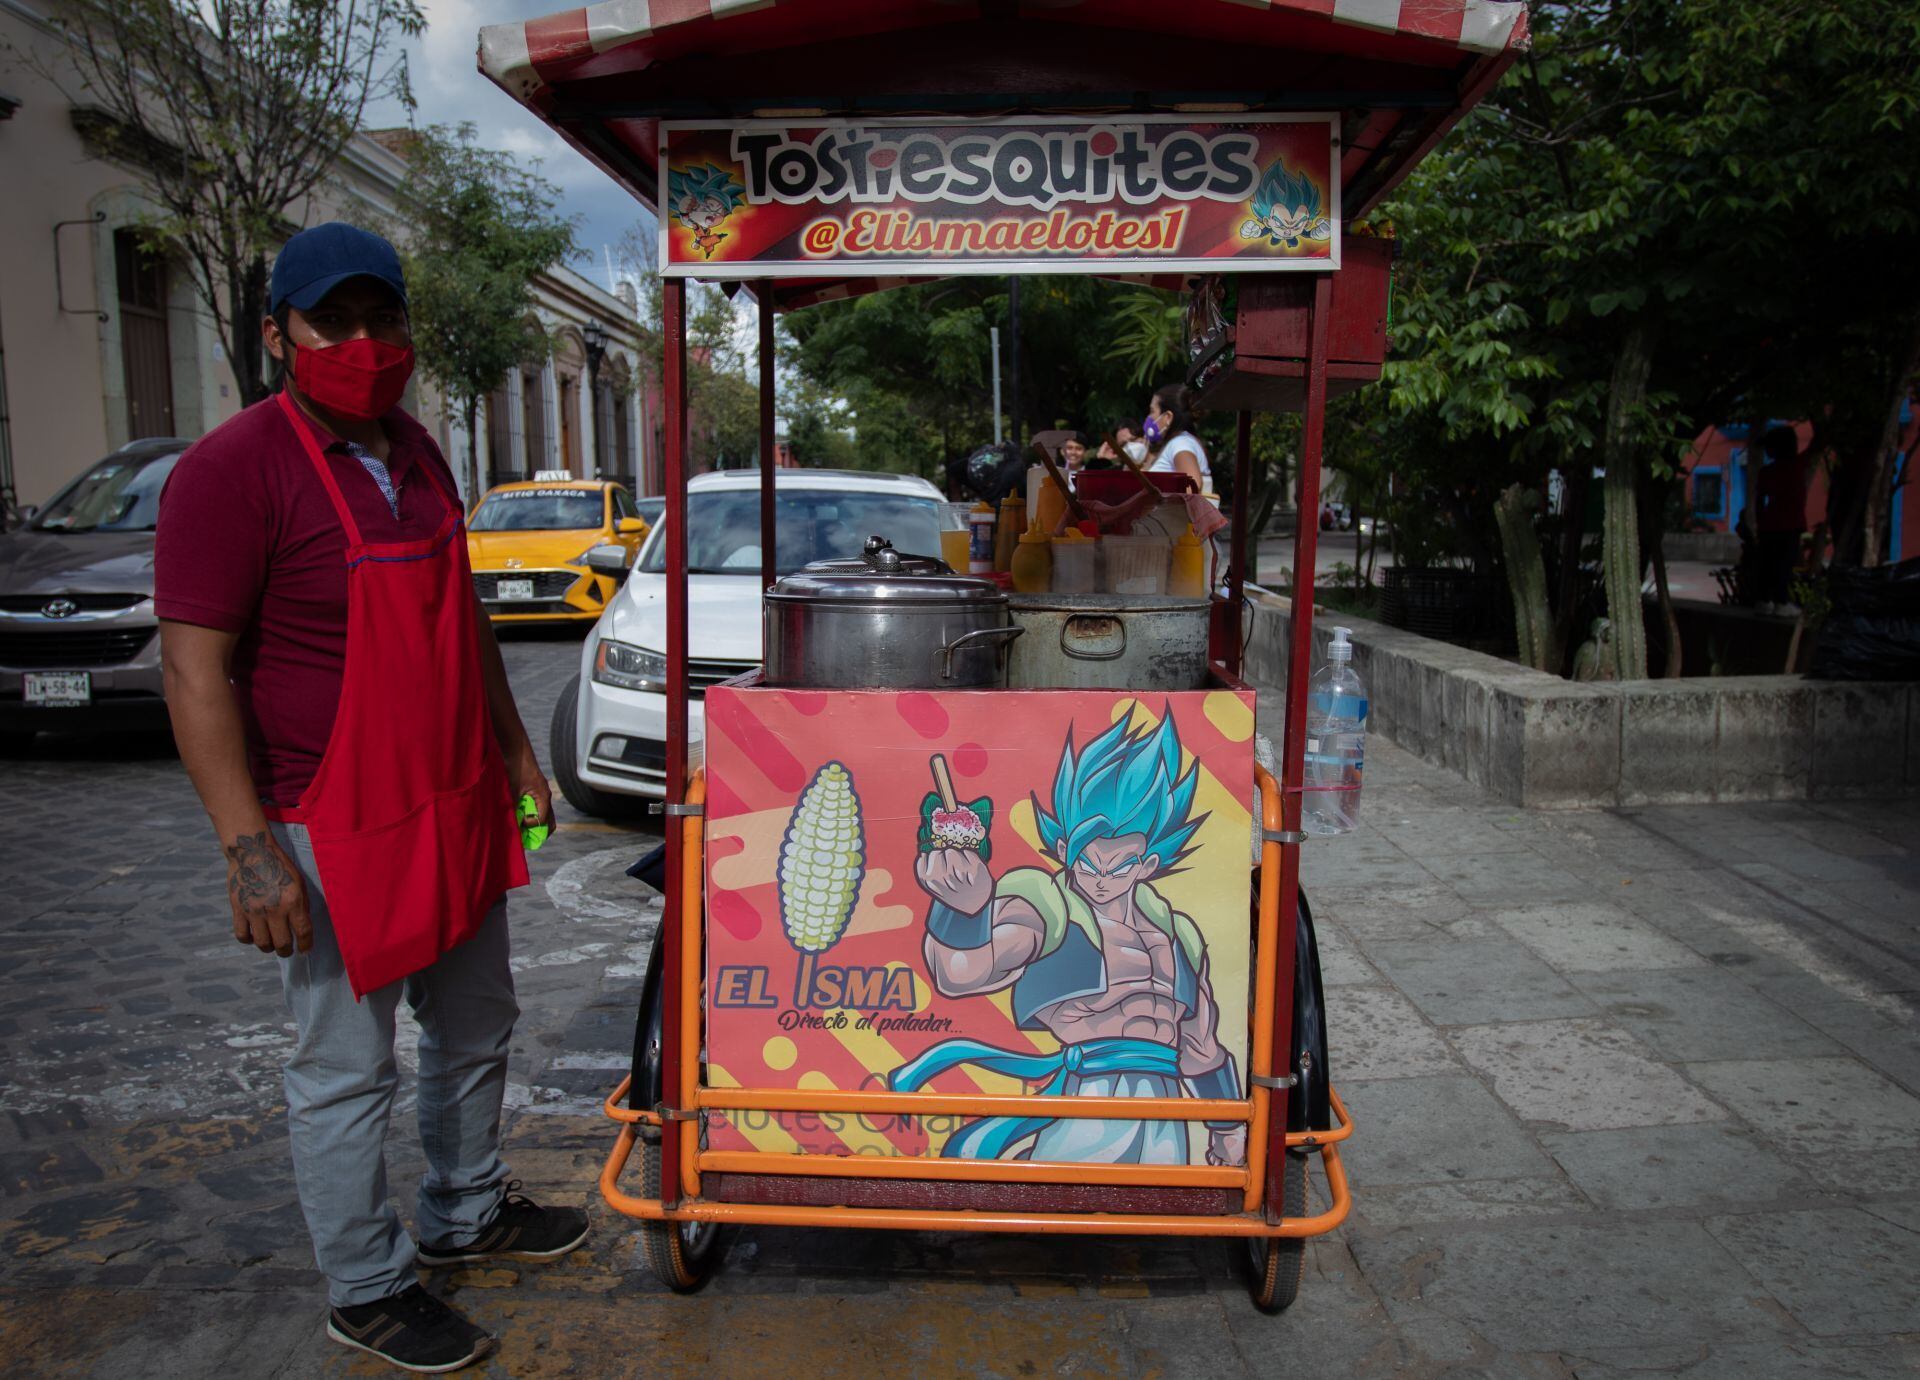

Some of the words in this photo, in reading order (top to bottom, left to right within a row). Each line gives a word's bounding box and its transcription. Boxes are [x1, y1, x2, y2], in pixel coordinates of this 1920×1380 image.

[804, 209, 1185, 254] @Elismaelotes1
[502, 490, 534, 499] SITIO
[537, 489, 586, 498] OAXACA
[716, 967, 777, 1007] EL
[795, 954, 916, 1009] ISMA
[777, 1009, 848, 1031] Directo
[855, 1012, 879, 1030] al
